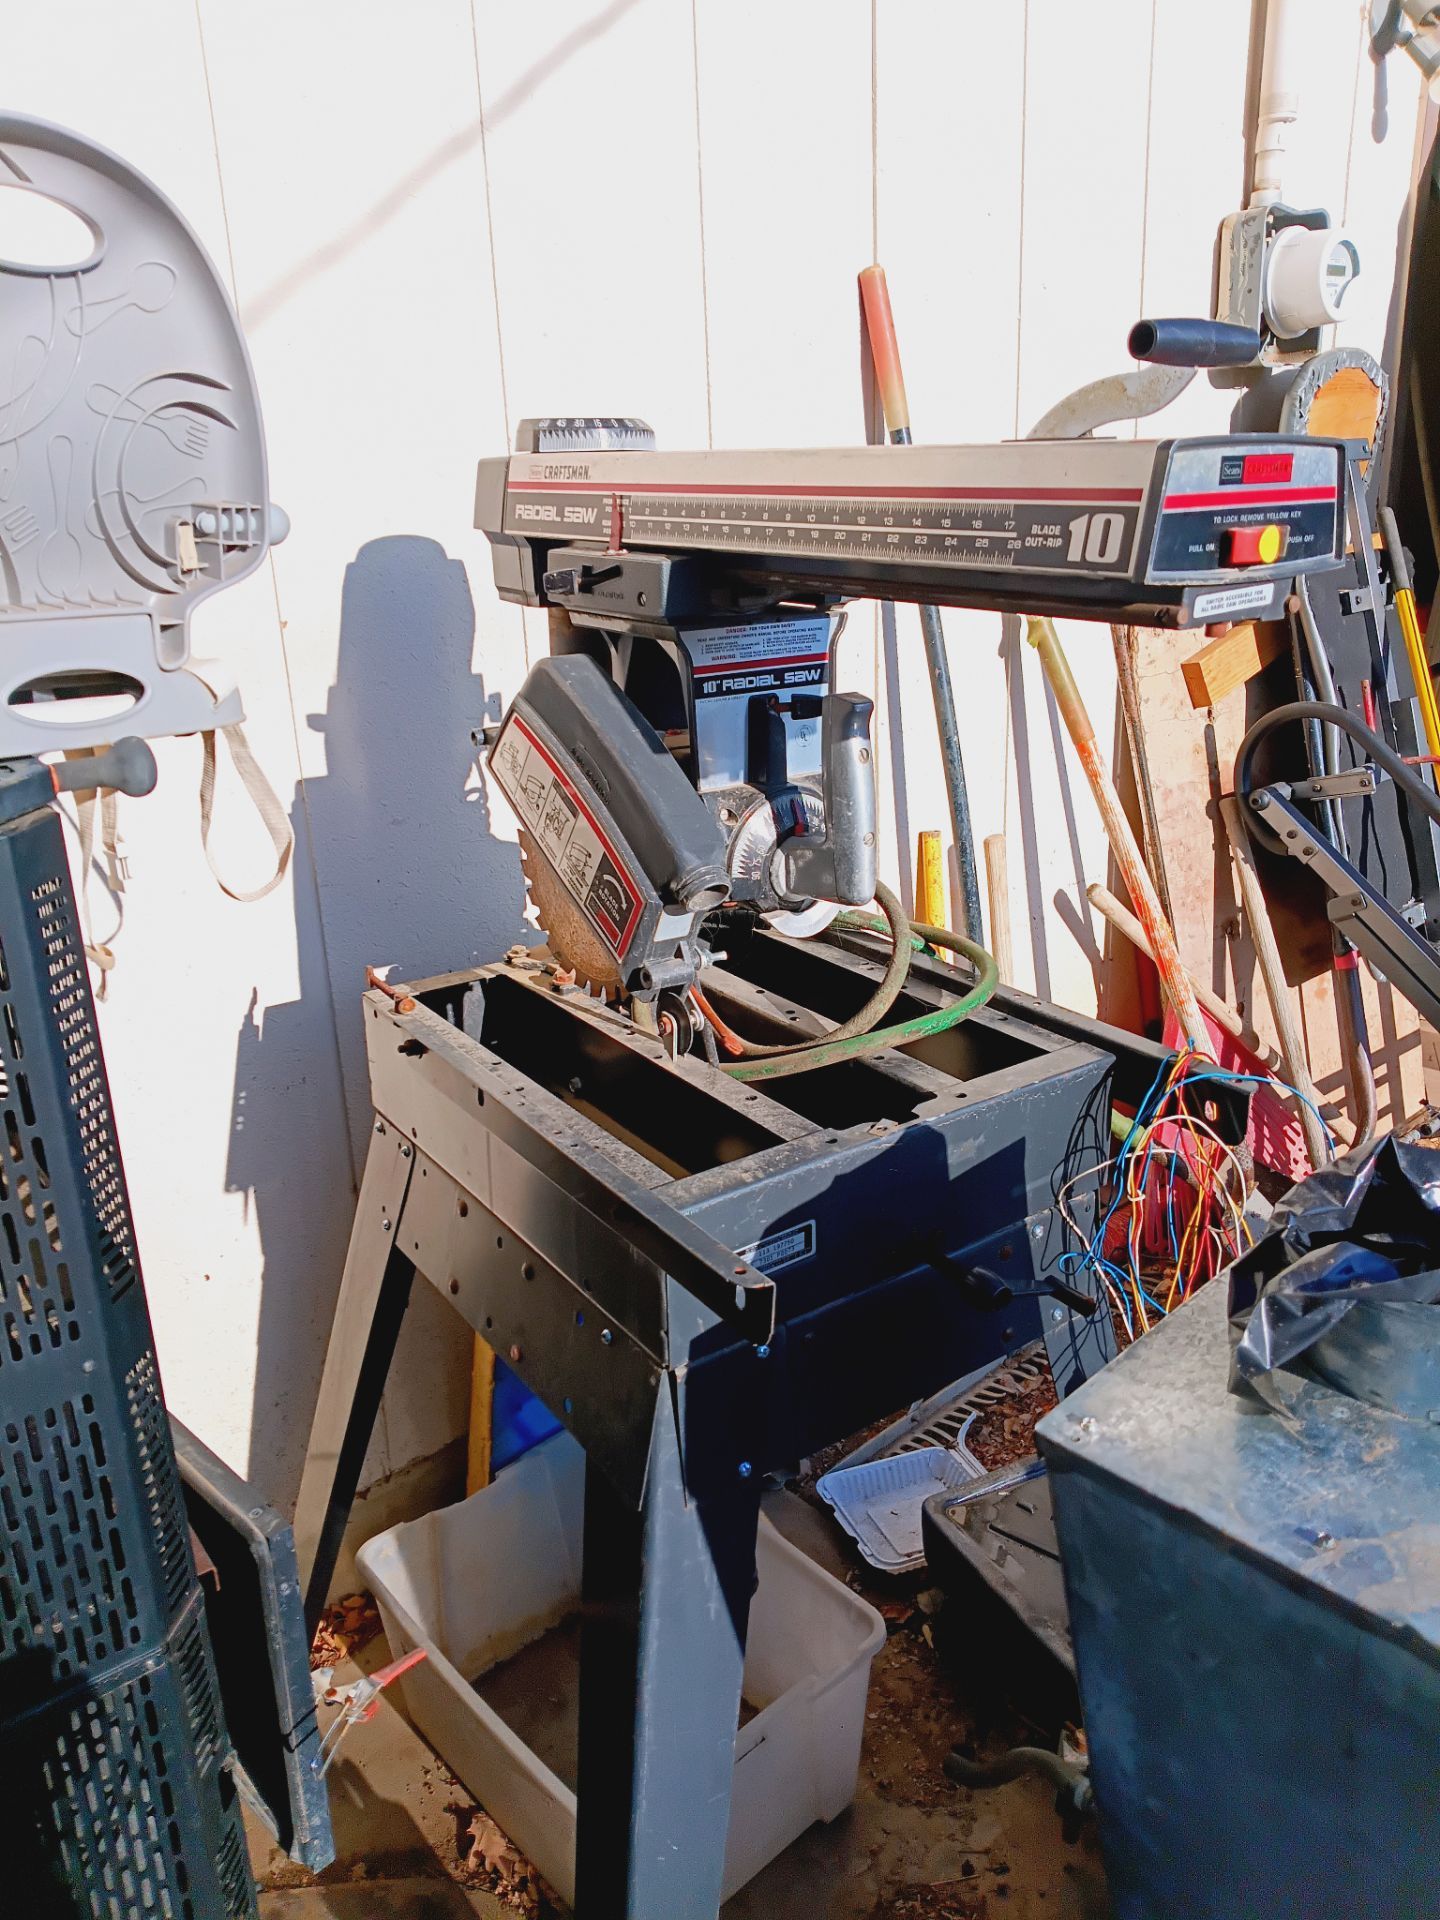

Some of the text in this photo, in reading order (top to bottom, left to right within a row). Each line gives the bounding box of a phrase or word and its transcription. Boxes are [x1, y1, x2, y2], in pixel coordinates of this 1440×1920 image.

[556, 419, 566, 427] 45
[574, 419, 584, 427] 30
[594, 419, 602, 427] 15
[611, 419, 618, 427] 0
[544, 465, 590, 480] CRAFTSMAN
[1224, 462, 1241, 476] Sears
[807, 514, 816, 522] 10
[857, 516, 866, 524] 12
[884, 517, 894, 526] 13
[912, 518, 922, 526] 14
[941, 519, 951, 528] 15
[972, 520, 983, 528] 16
[1004, 521, 1016, 530] 17
[1222, 514, 1238, 523] LOCK
[1240, 513, 1264, 522] REMOVE
[1266, 512, 1290, 520] YELLOW
[1290, 510, 1302, 519] KEY
[683, 524, 690, 532] 13
[744, 527, 751, 535] 16
[834, 532, 846, 540] 20
[862, 533, 872, 541] 21
[887, 534, 900, 543] 22
[915, 536, 928, 544] 23
[945, 537, 958, 546] 24
[975, 538, 990, 548] 25
[1007, 540, 1022, 549] 26
[1031, 524, 1061, 536] BLADE
[1024, 536, 1062, 548] OUT-RIP
[1066, 513, 1126, 564] 10
[1304, 534, 1315, 542] OFF
[1188, 543, 1215, 552] PULL ON
[602, 887, 619, 910] BLADE
